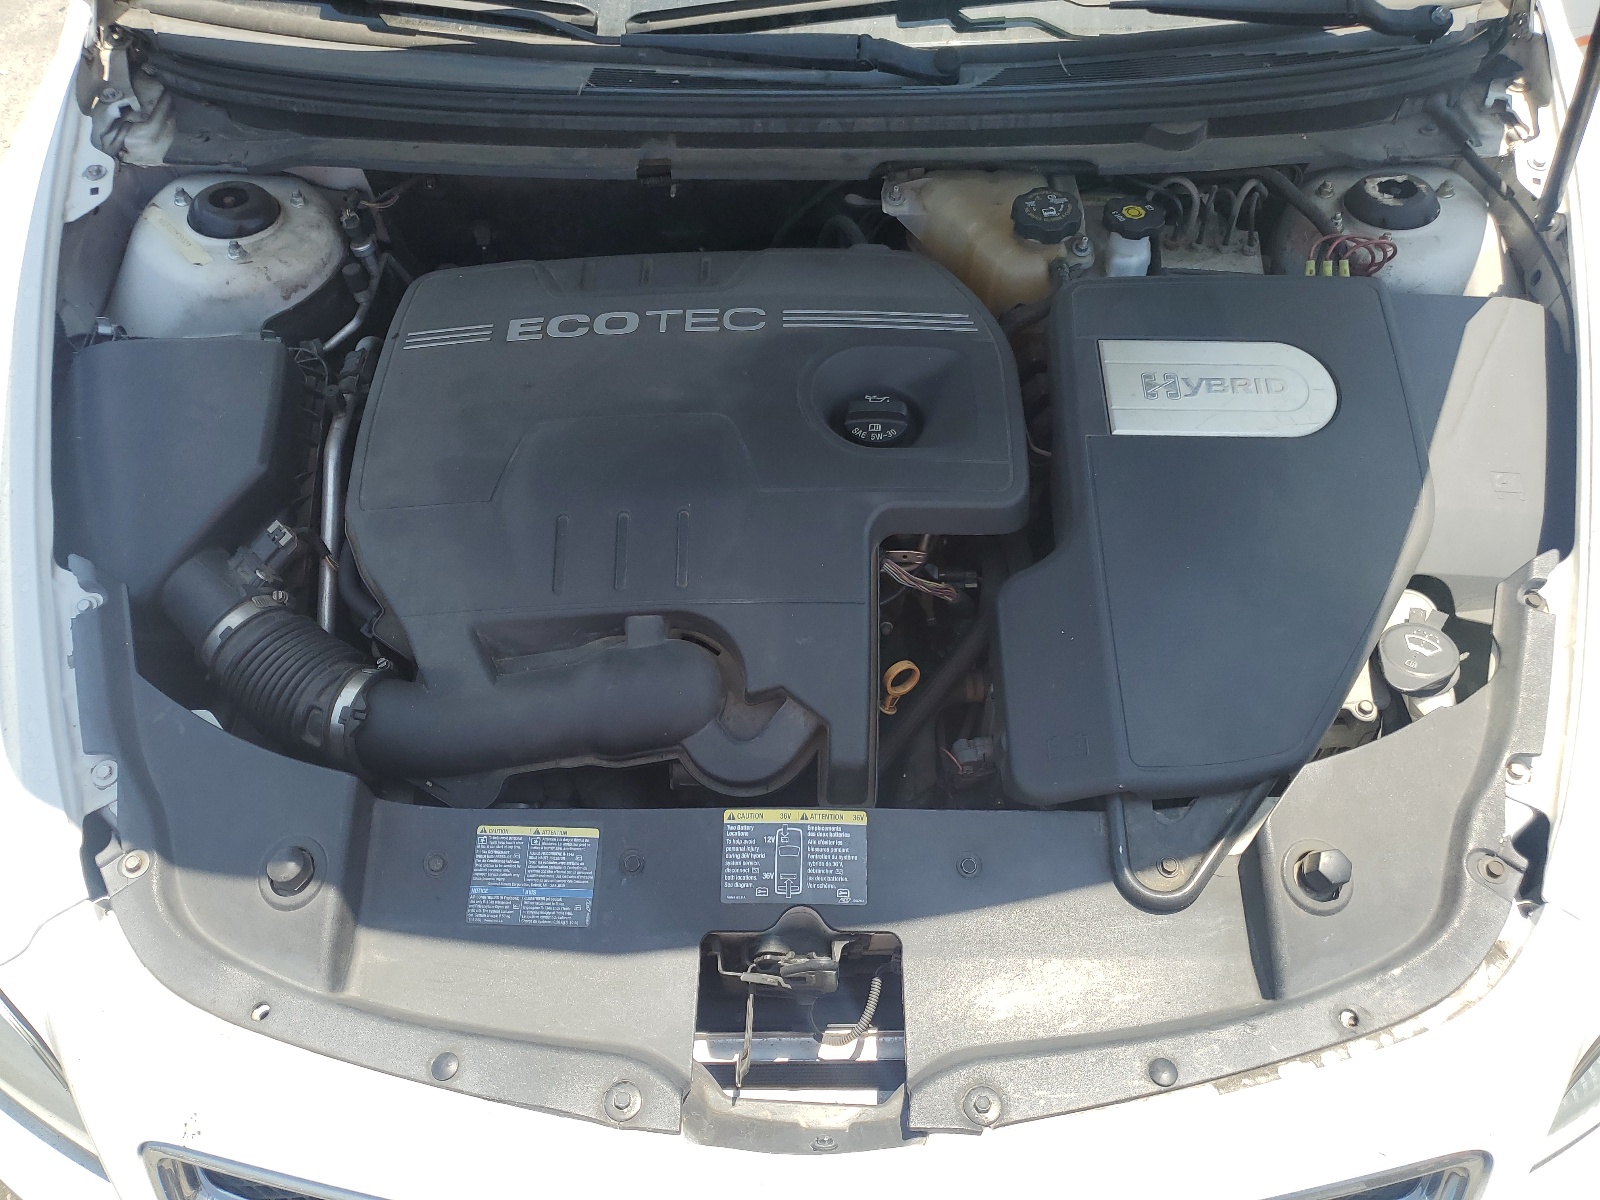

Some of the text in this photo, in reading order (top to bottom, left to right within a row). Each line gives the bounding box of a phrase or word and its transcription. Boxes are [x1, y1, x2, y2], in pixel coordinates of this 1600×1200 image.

[506, 307, 766, 342] ECOTEC
[1140, 372, 1288, 401] HYBRID
[852, 428, 897, 440] SAE 5W-30
